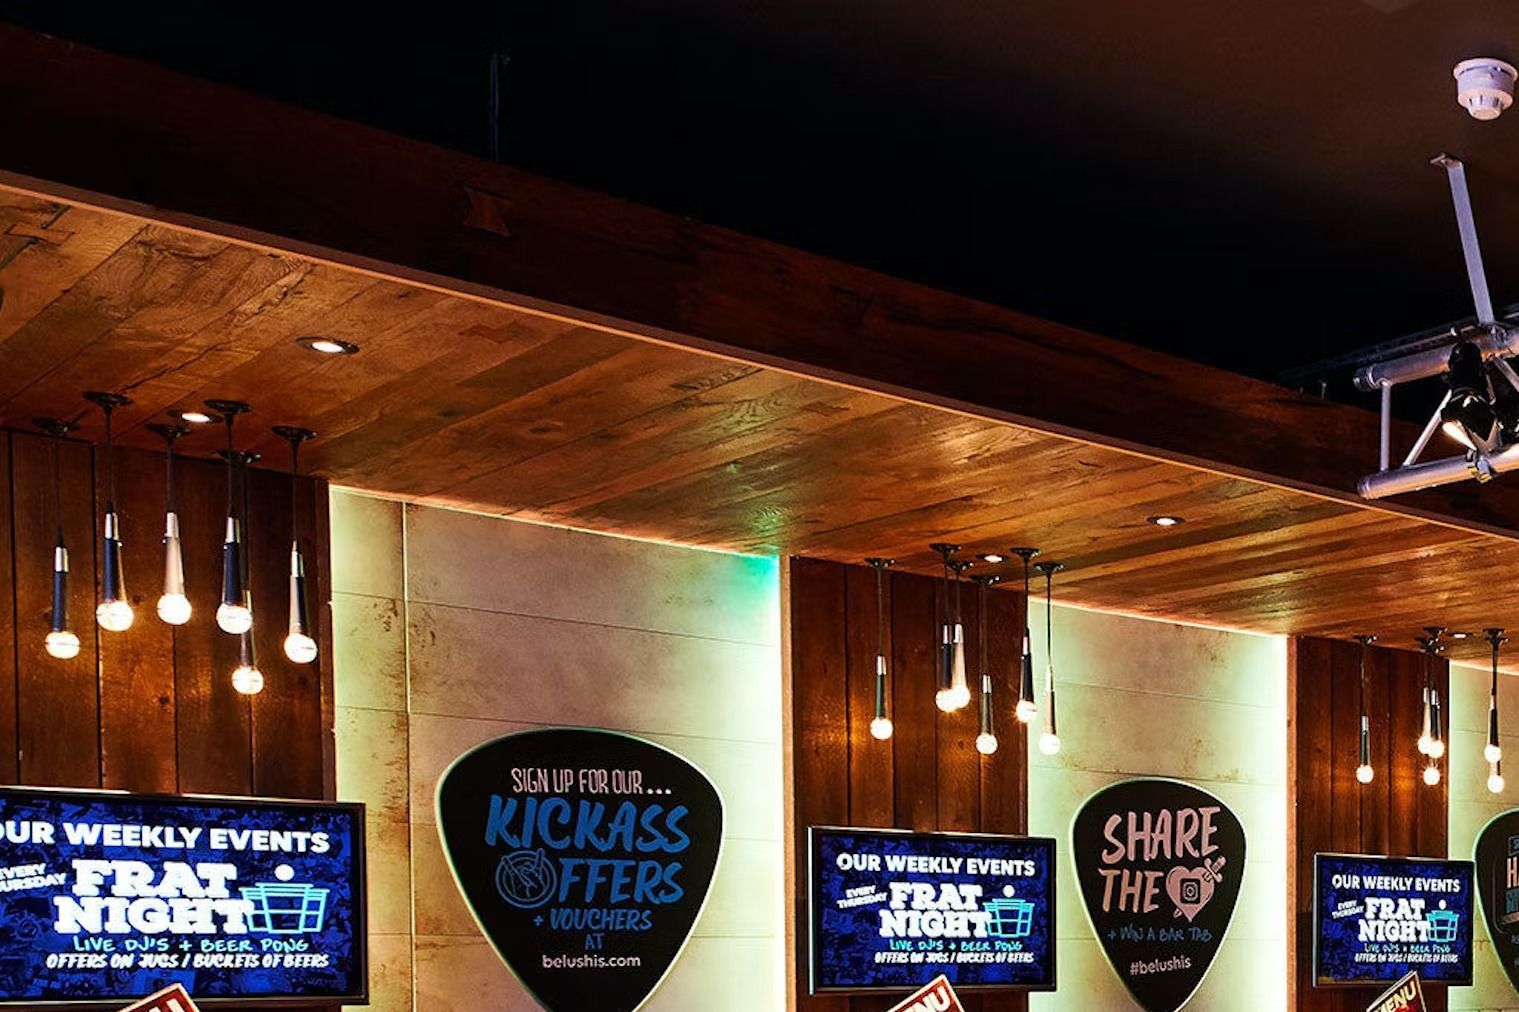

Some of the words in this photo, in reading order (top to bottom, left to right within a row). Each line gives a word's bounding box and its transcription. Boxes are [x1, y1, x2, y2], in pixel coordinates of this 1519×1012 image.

[511, 768, 548, 793] SIGN
[552, 768, 574, 793] UP
[579, 768, 609, 794] FOR
[485, 794, 691, 854] KICKASS
[1101, 806, 1221, 865] SHARE
[0, 820, 55, 845] UR
[63, 822, 202, 849] WEEKLY
[210, 828, 330, 854] EVENTS
[836, 852, 881, 871] OUR
[884, 855, 964, 874] WEEKLY
[966, 858, 1035, 877] EVENTS
[71, 859, 238, 897] FRAT
[1097, 868, 1165, 913] THE
[1331, 874, 1360, 890] OUR
[1362, 876, 1413, 891] WEEKLY
[1415, 877, 1461, 893] EVENTS
[889, 882, 983, 911] FRAT
[1365, 897, 1426, 921] FRAT
[53, 896, 255, 935] NIGHT
[550, 908, 653, 931] VOUCHERS
[879, 909, 992, 938] NIGHT
[584, 932, 605, 950] AT
[1159, 927, 1185, 942] BAR
[1358, 918, 1431, 943] NIGHT
[73, 936, 116, 952] LIVE
[125, 936, 169, 952] DJ'S
[200, 939, 253, 952] BEER
[260, 938, 309, 953] PONG
[889, 939, 914, 951] LIVE
[46, 953, 108, 968] OFFERS
[110, 954, 134, 968] ON
[138, 953, 180, 968] JUGS
[193, 953, 260, 968] BUCKETS
[262, 953, 282, 968] OF
[283, 953, 330, 968] BEERS
[542, 954, 641, 968] belushis.com
[1129, 955, 1192, 976] #belushis
